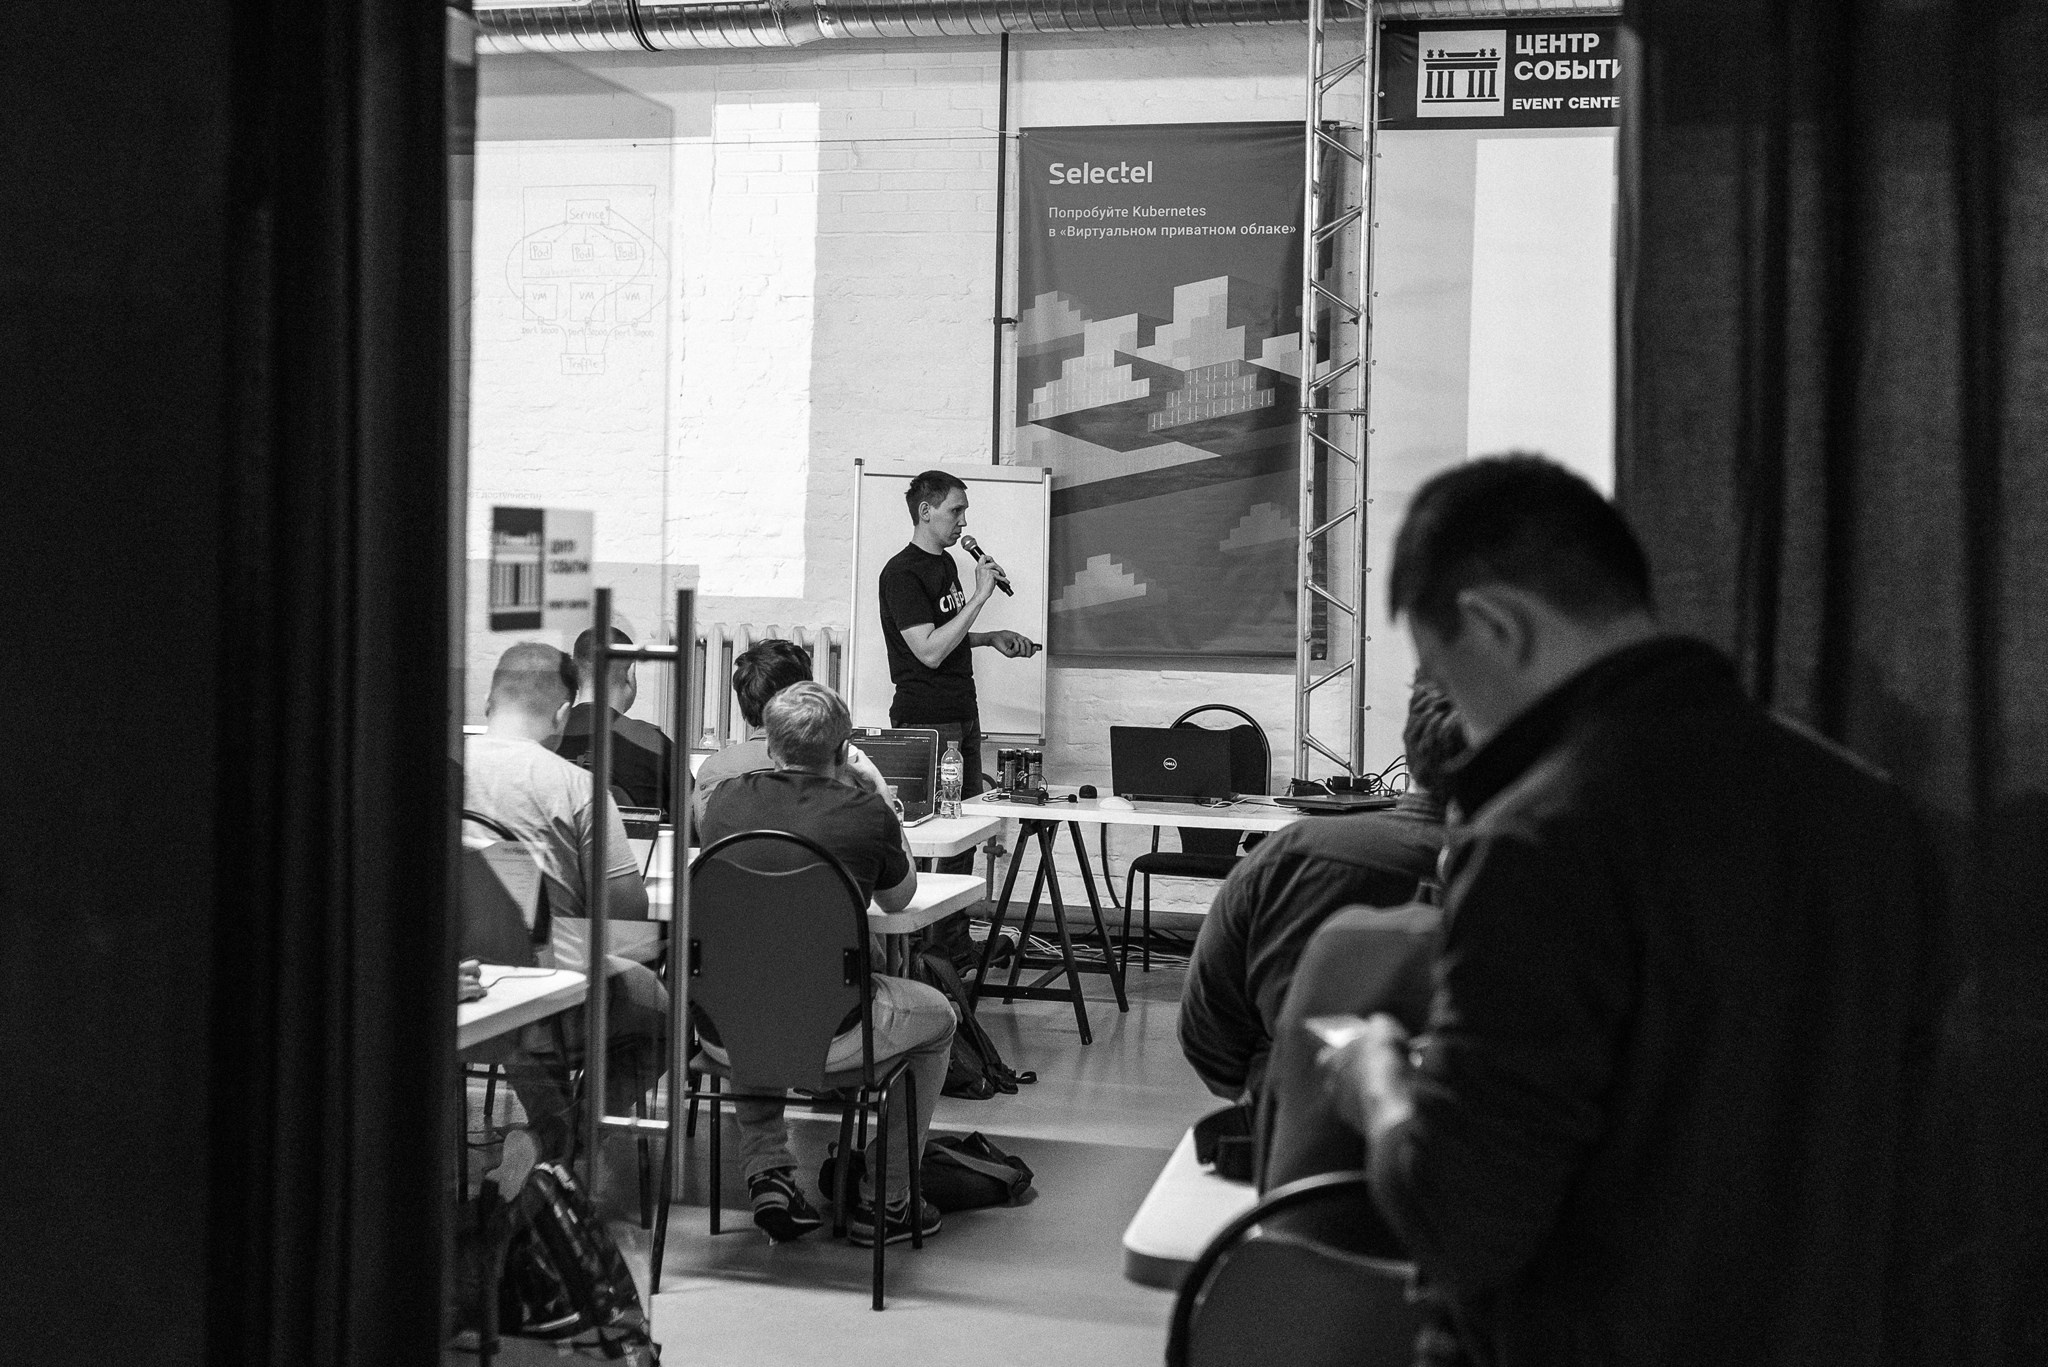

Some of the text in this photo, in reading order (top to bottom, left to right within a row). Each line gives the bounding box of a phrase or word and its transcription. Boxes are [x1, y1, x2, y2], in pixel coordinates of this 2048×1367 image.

[1515, 33, 1600, 56] ЦЕНТР
[1512, 97, 1564, 110] EVENT
[1048, 160, 1153, 185] Selectel
[569, 207, 606, 221] Service
[1048, 205, 1207, 221] Попробуйте Kubernetes
[1048, 222, 1297, 240] в «Виртуальном приватном облаке»
[532, 244, 550, 258] Pod
[575, 247, 592, 260] Pod
